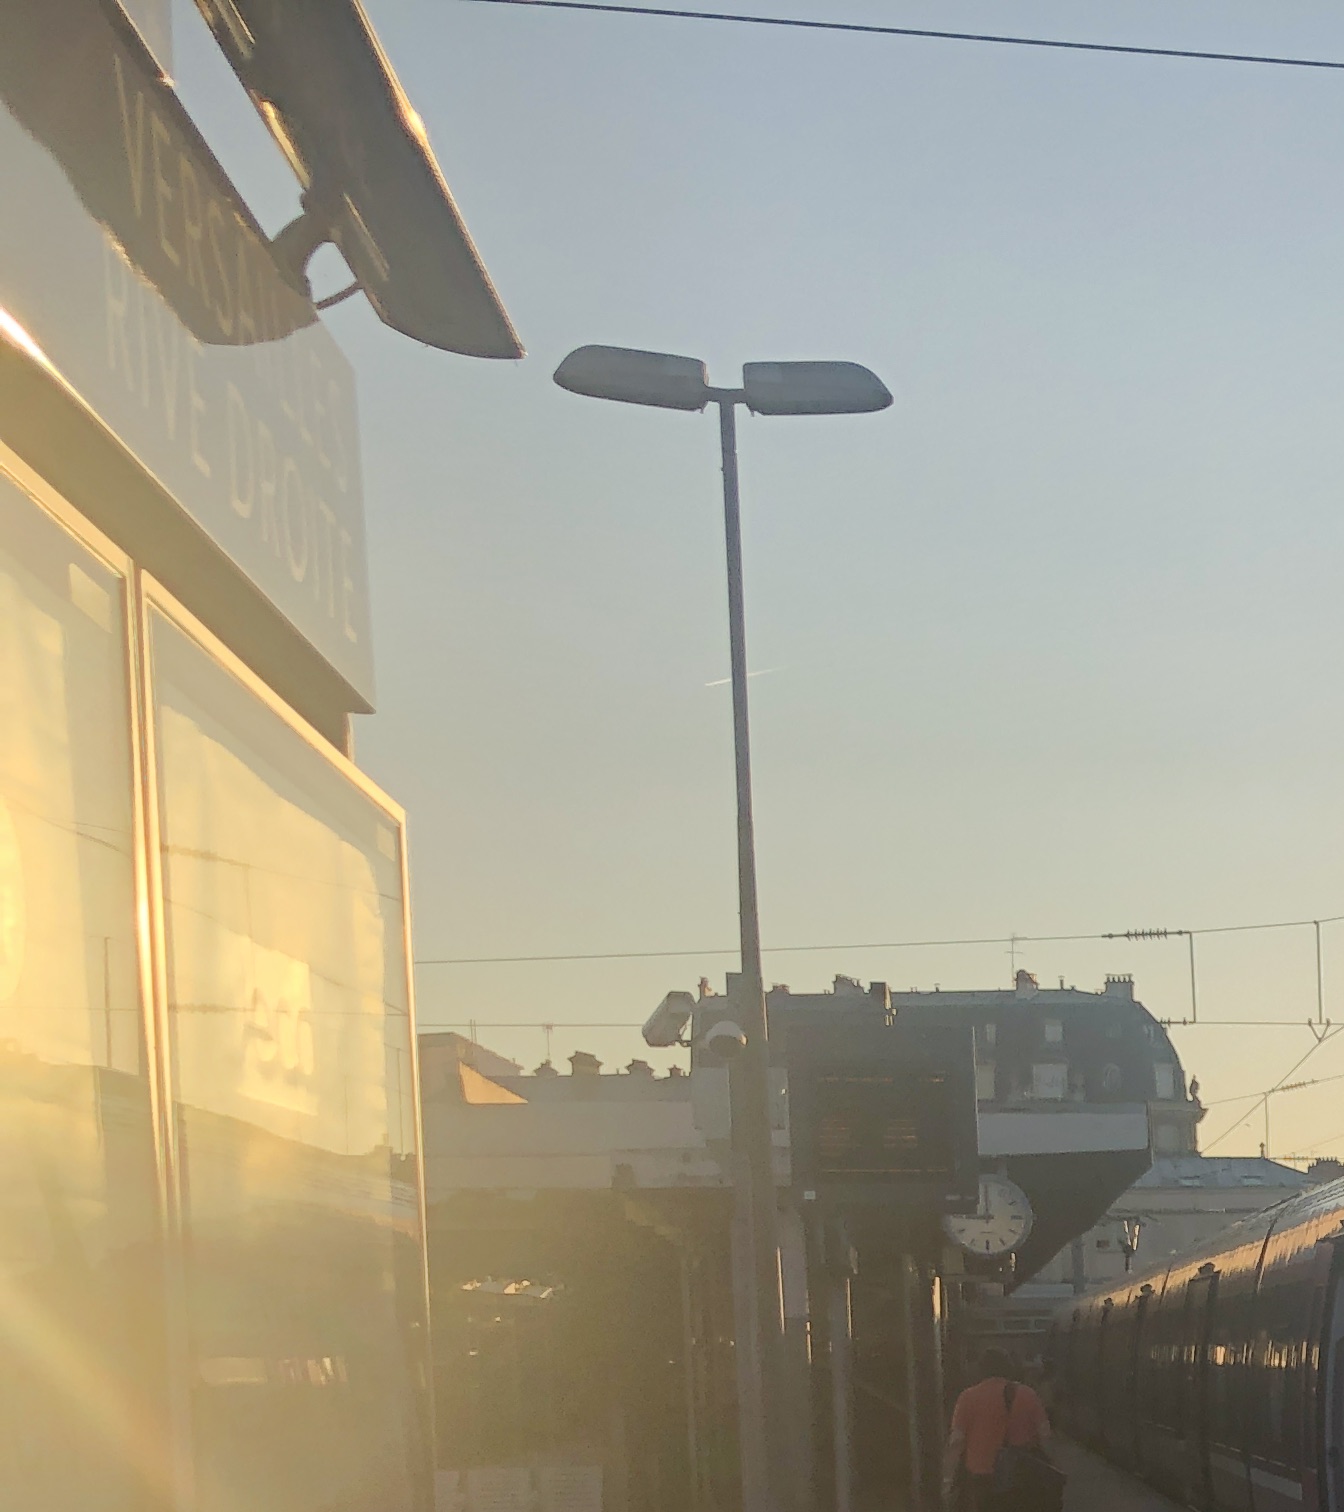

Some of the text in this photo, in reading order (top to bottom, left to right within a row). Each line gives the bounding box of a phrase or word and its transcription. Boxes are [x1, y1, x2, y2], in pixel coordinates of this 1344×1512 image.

[102, 233, 359, 645] RIVE DROITE
[112, 53, 350, 494] VERSAILLES
